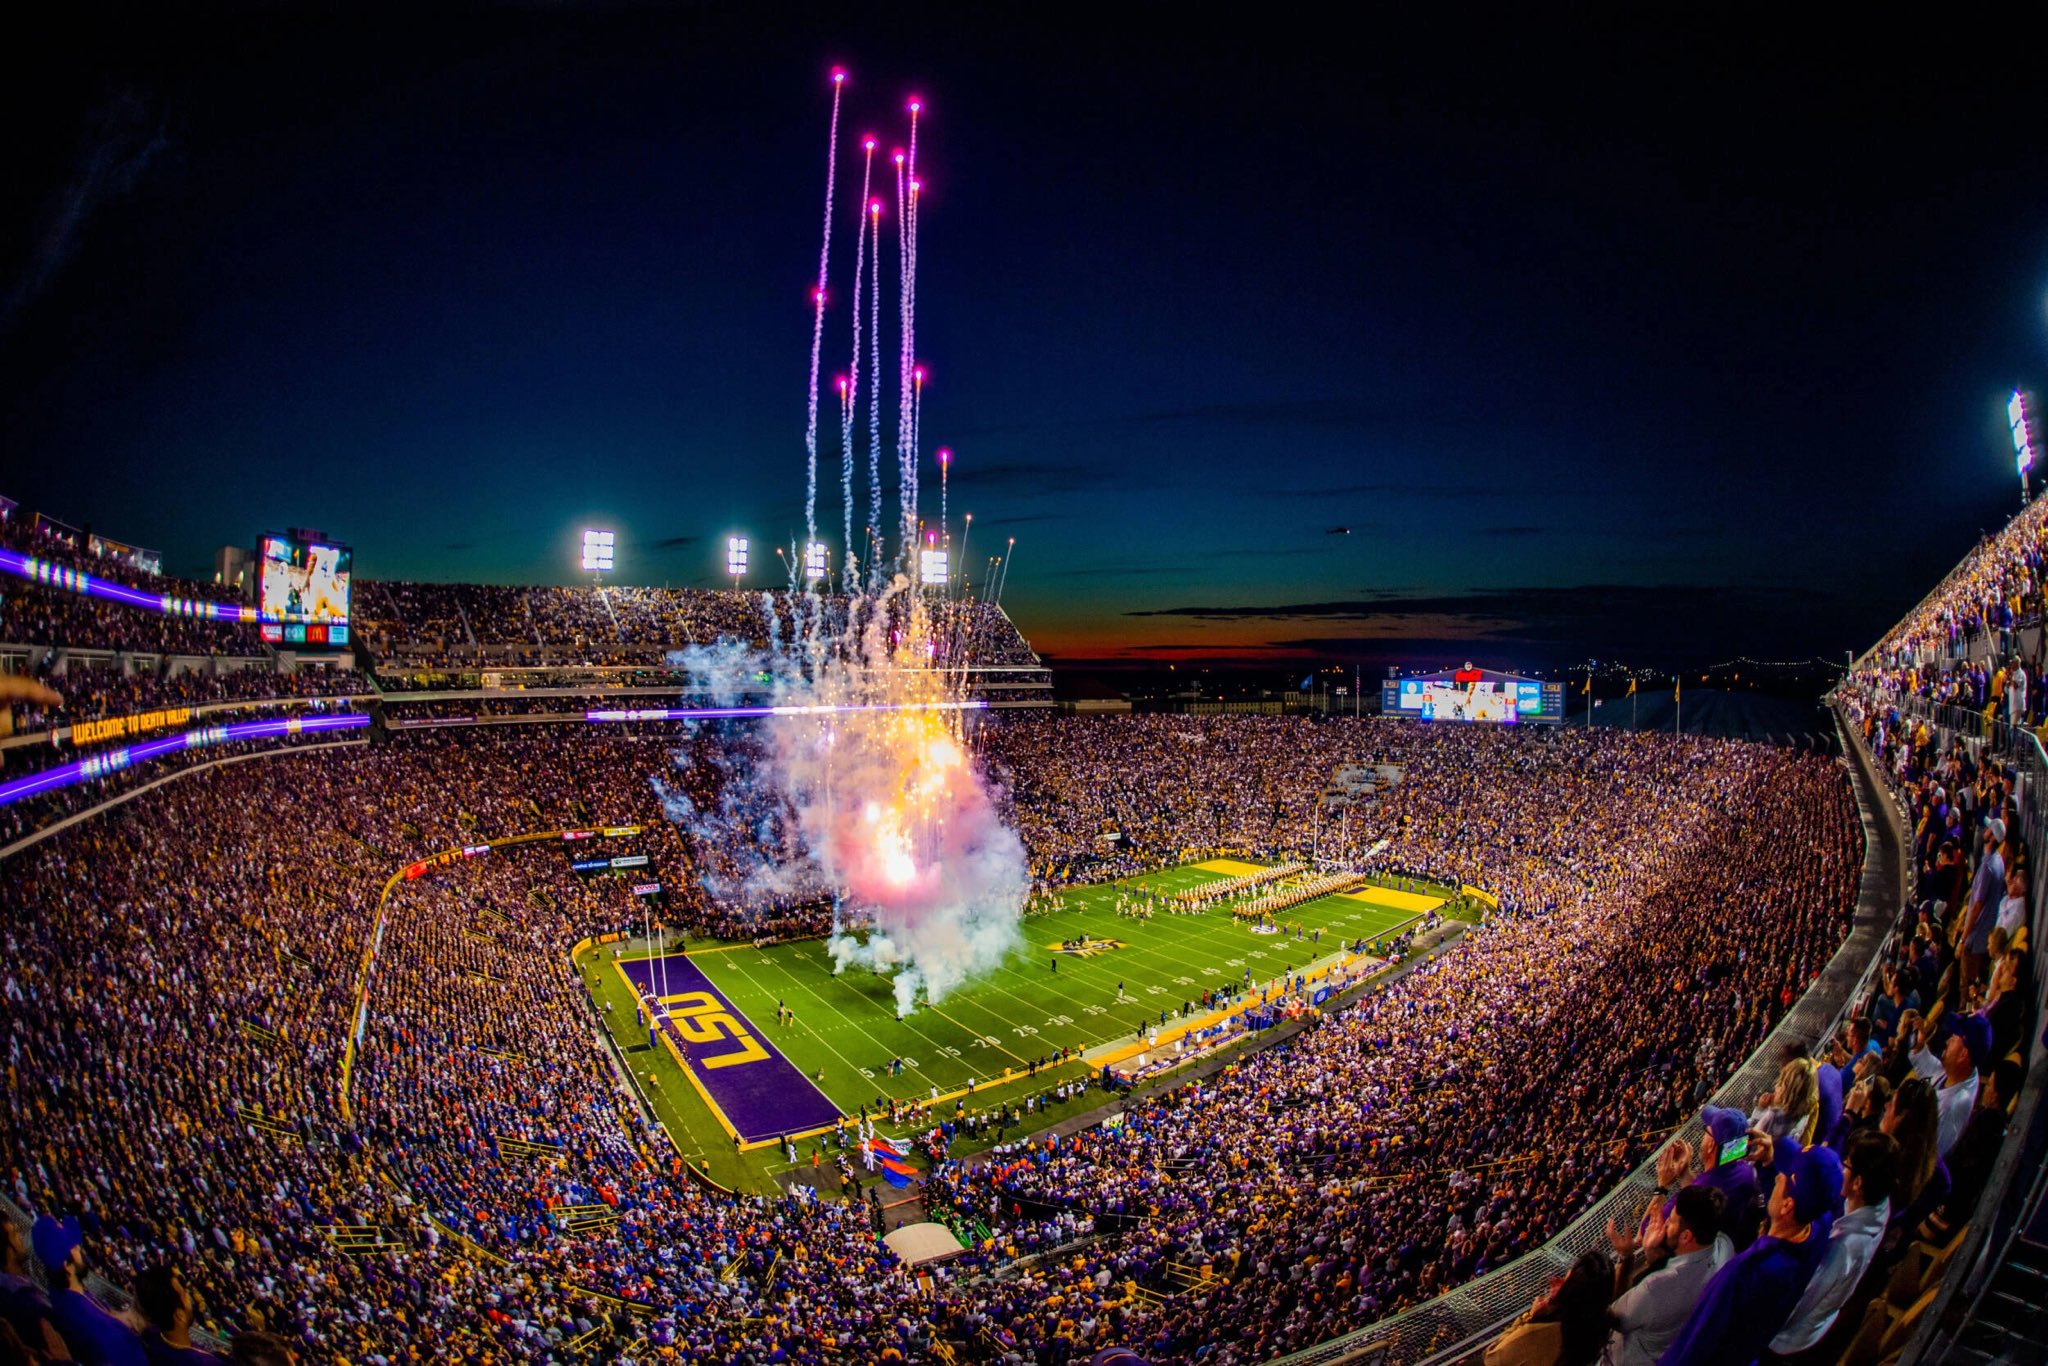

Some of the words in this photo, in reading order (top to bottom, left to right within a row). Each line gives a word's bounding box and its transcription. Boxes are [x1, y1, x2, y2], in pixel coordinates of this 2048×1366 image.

[72, 717, 125, 746] WELCOME
[126, 715, 139, 734] TO
[140, 710, 166, 731] DEATH
[166, 707, 190, 725] VALLEY
[1082, 1004, 1107, 1015] 35
[1048, 1014, 1074, 1026] 30
[657, 991, 772, 1070] LSU
[1012, 1025, 1039, 1037] 25
[974, 1035, 1001, 1048] 20
[935, 1046, 961, 1059] 15
[860, 1067, 875, 1078] 5
